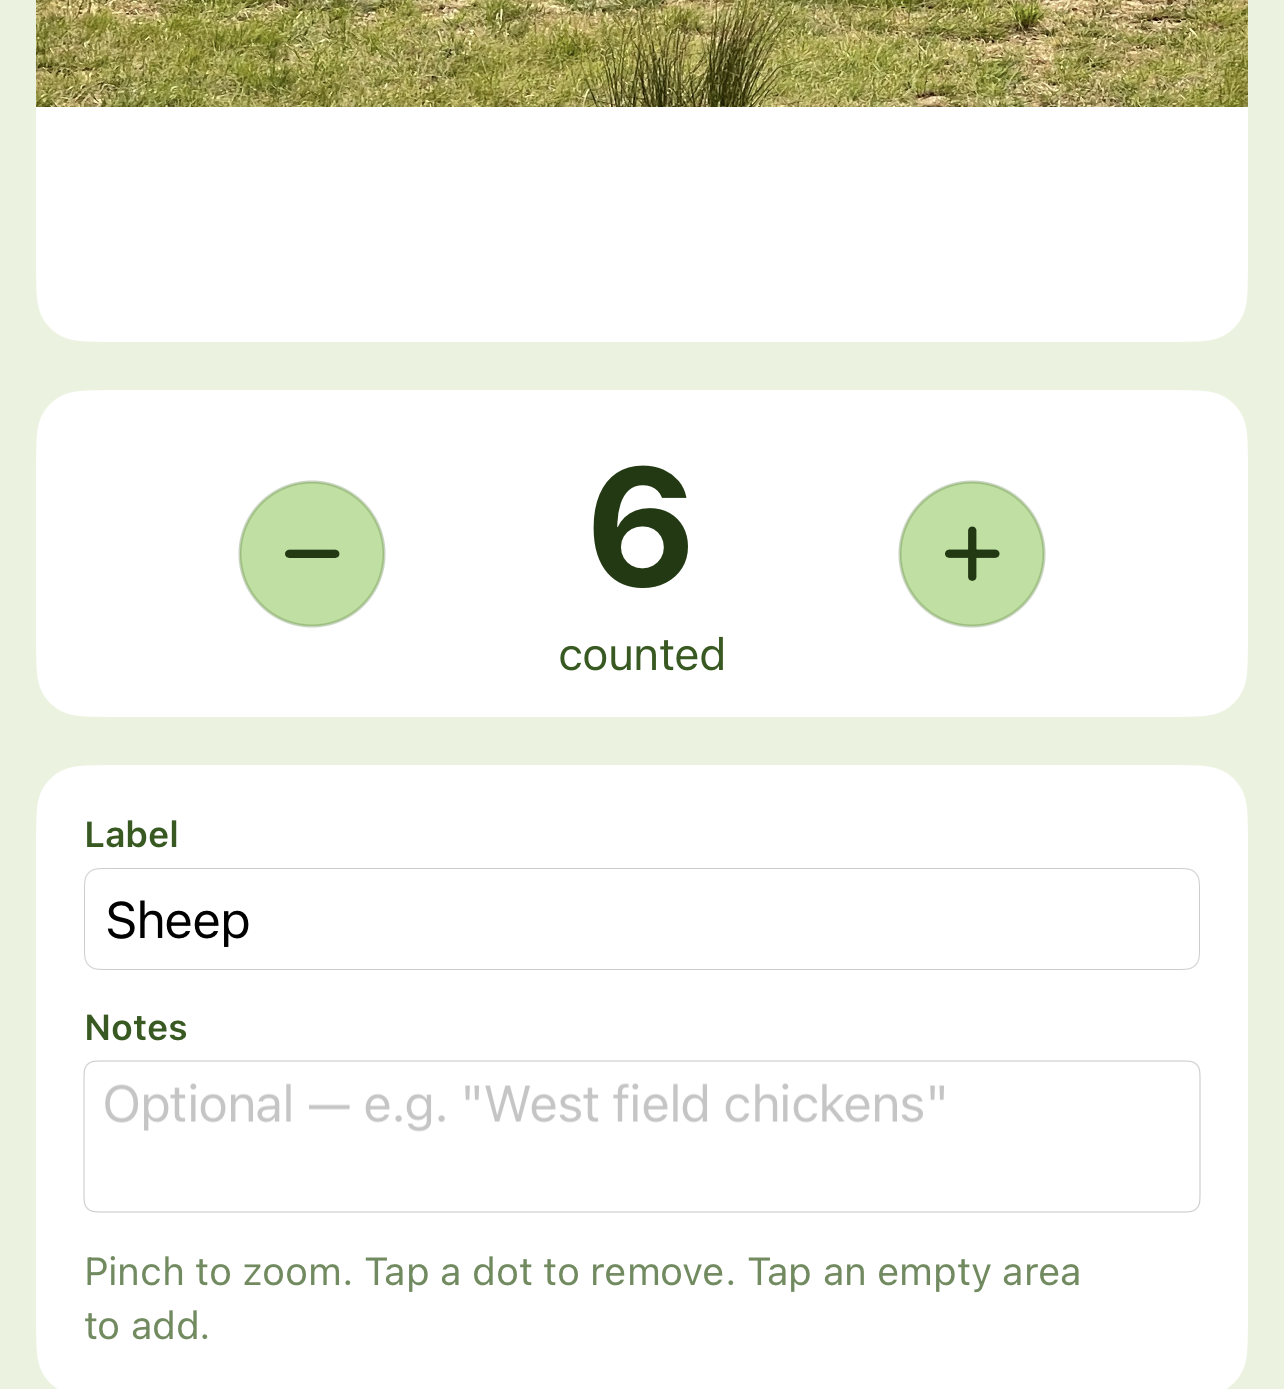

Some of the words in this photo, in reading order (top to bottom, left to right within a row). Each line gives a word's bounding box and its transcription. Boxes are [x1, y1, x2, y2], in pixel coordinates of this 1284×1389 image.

[592, 464, 689, 589] 6
[559, 636, 724, 672] counted
[86, 819, 178, 849] Label
[107, 899, 250, 948] Sheep
[86, 1013, 187, 1042] Notes
[104, 1083, 292, 1132] Optional
[365, 1093, 446, 1132] e.g.
[464, 1083, 599, 1123] "West
[612, 1083, 708, 1123] field
[725, 1083, 945, 1123] chickens"
[86, 1255, 183, 1287] Pinch
[195, 1258, 231, 1287] to
[243, 1263, 351, 1287] zoom.
[365, 1256, 429, 1293] Tap
[441, 1263, 460, 1287] a
[473, 1255, 533, 1287] dot
[543, 1258, 579, 1287] to
[592, 1263, 734, 1287] remove.
[748, 1256, 811, 1293] Tap
[824, 1263, 865, 1287] an
[878, 1258, 992, 1293] empty
[1003, 1263, 1080, 1287] area
[84, 1312, 119, 1341] to
[132, 1309, 208, 1341] add.
